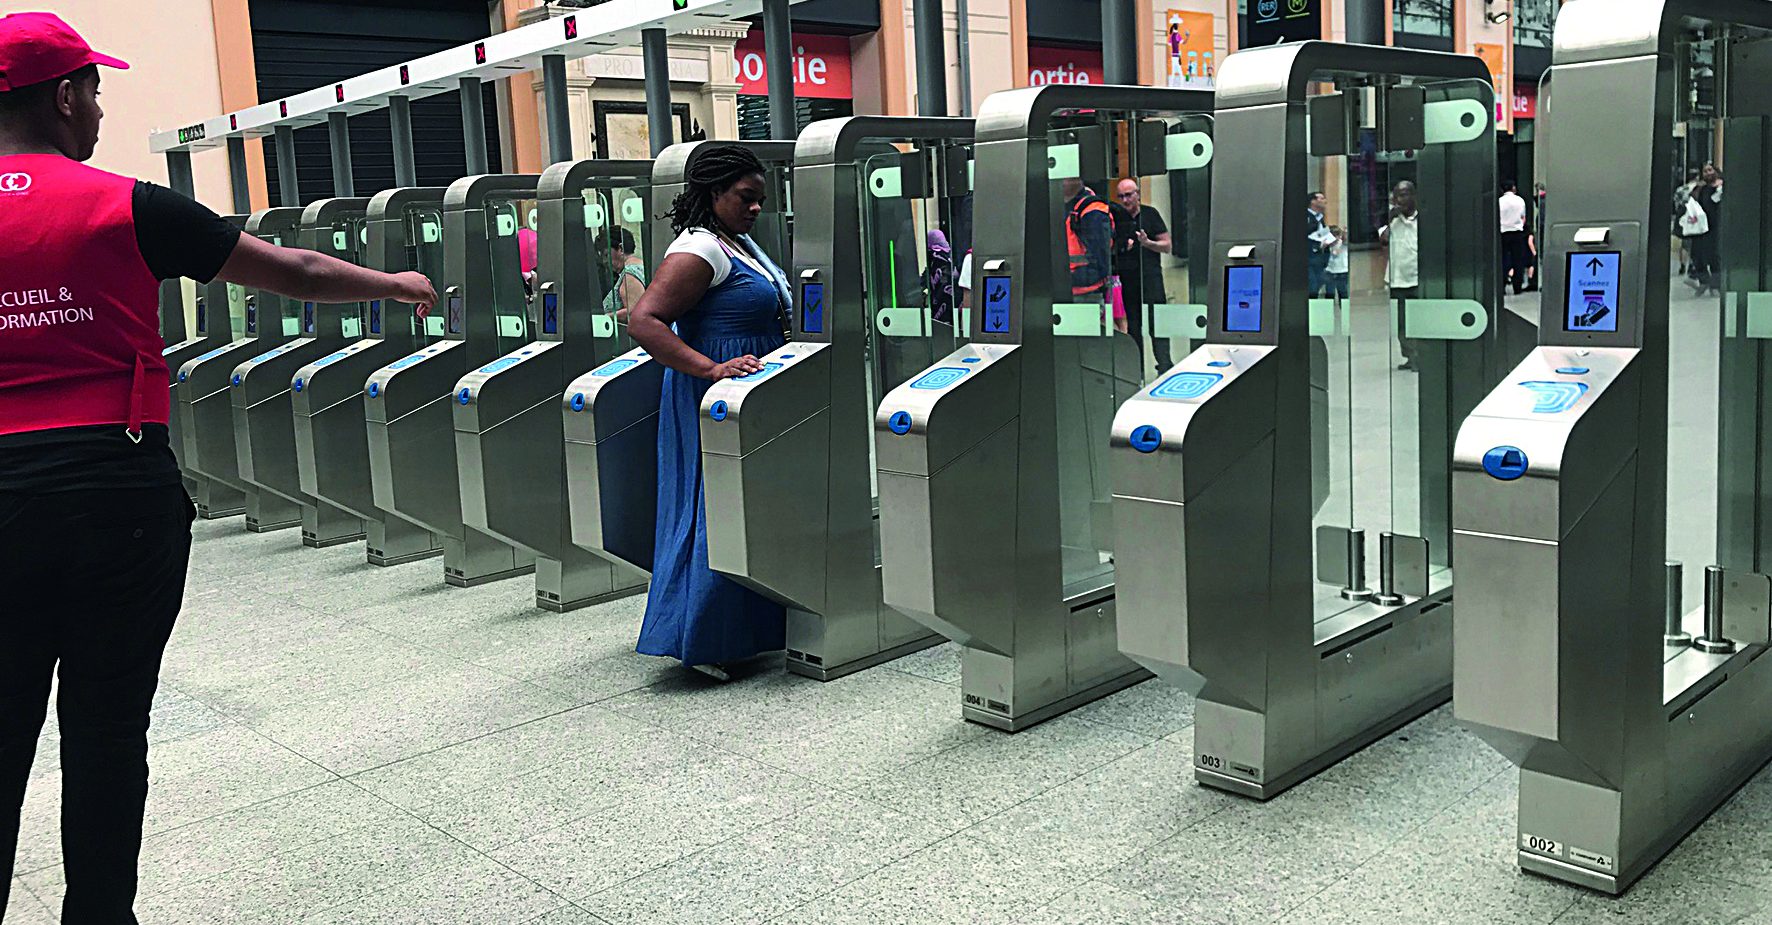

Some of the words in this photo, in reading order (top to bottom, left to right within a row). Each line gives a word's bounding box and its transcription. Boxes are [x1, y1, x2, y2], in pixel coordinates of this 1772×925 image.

[603, 57, 633, 76] PRO
[670, 62, 693, 78] RIA
[734, 45, 827, 85] oie
[0, 288, 55, 308] CUEIL
[58, 286, 73, 302] &
[1201, 754, 1220, 769] 003
[1529, 836, 1556, 854] 002
